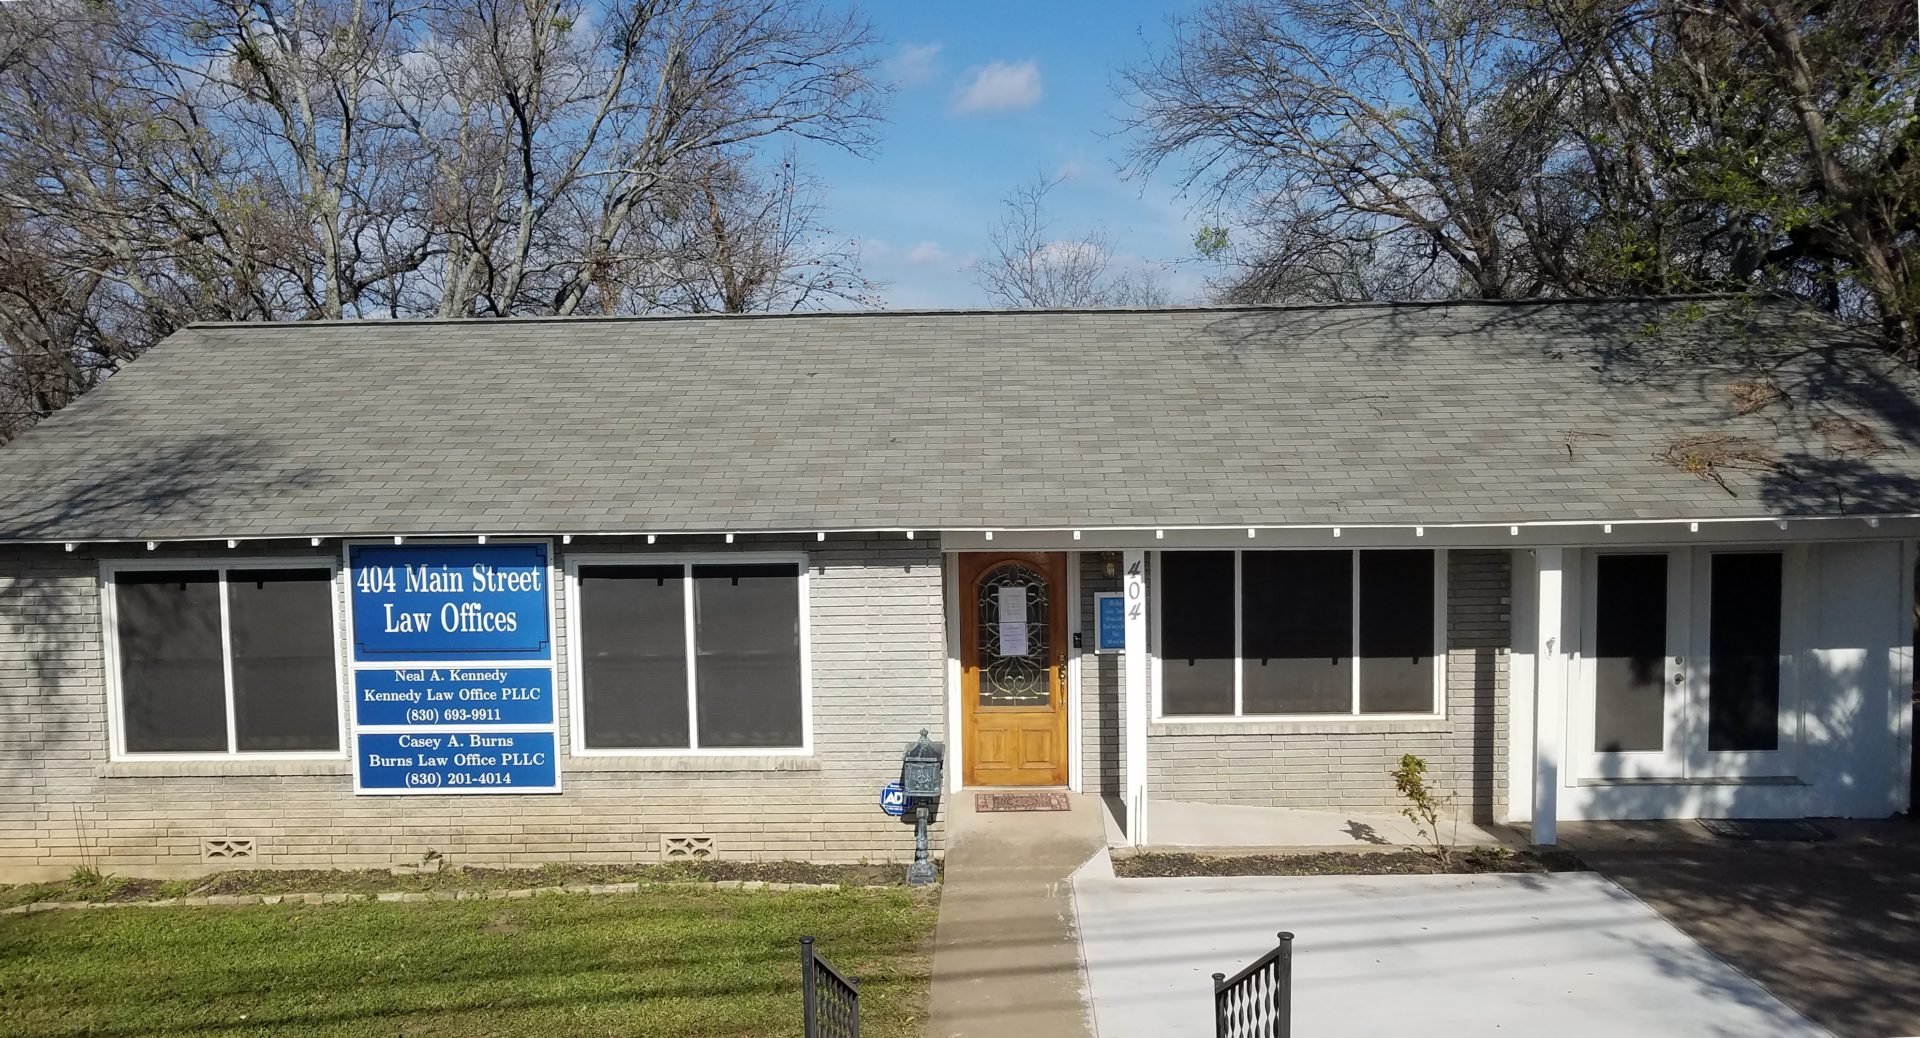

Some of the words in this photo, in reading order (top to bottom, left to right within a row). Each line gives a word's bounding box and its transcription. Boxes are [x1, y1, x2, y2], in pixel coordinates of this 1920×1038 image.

[357, 565, 396, 593] 404
[405, 563, 464, 593] Main
[472, 562, 541, 593] Street
[1127, 560, 1142, 621] 404
[384, 603, 432, 633] Law
[440, 602, 517, 633] Offices
[394, 669, 425, 682] Neal
[430, 670, 445, 682] A.
[450, 669, 508, 684] Kennedy
[364, 689, 422, 703] Kennedy
[426, 689, 454, 701] Law
[459, 688, 497, 701] Office
[501, 687, 541, 701] PLLC
[406, 708, 439, 725] (830)
[444, 708, 501, 721] 693-9911
[398, 735, 442, 750] Casey
[447, 735, 464, 748] A.
[469, 734, 514, 747] Burns
[369, 755, 413, 767] Burns
[418, 754, 448, 767] Law
[454, 753, 496, 766] Office
[501, 753, 545, 766] PLLC
[405, 772, 442, 788] (830)
[447, 773, 512, 785] 201-4014
